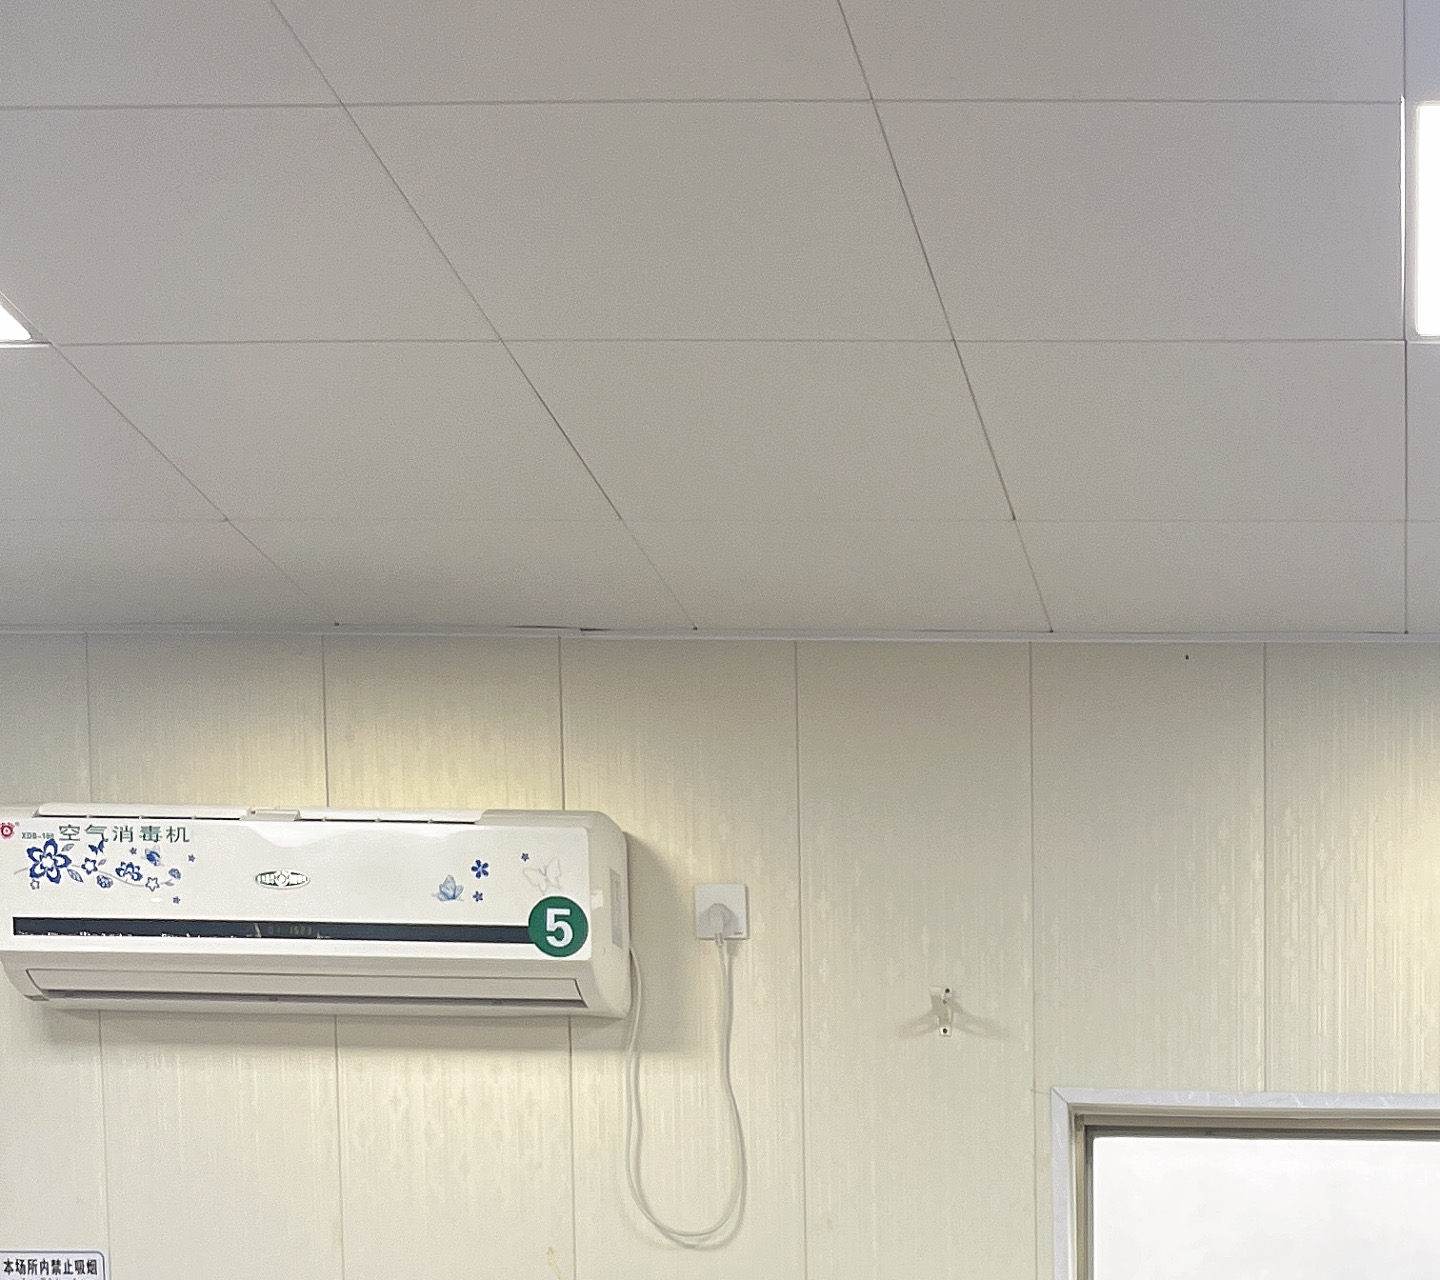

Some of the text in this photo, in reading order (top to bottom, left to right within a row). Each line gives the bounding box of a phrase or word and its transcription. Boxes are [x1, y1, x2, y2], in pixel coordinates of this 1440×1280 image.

[58, 824, 190, 843] 空气消毒机
[546, 908, 573, 948] 5
[3, 1258, 98, 1275] 本场所内禁止吸烟
